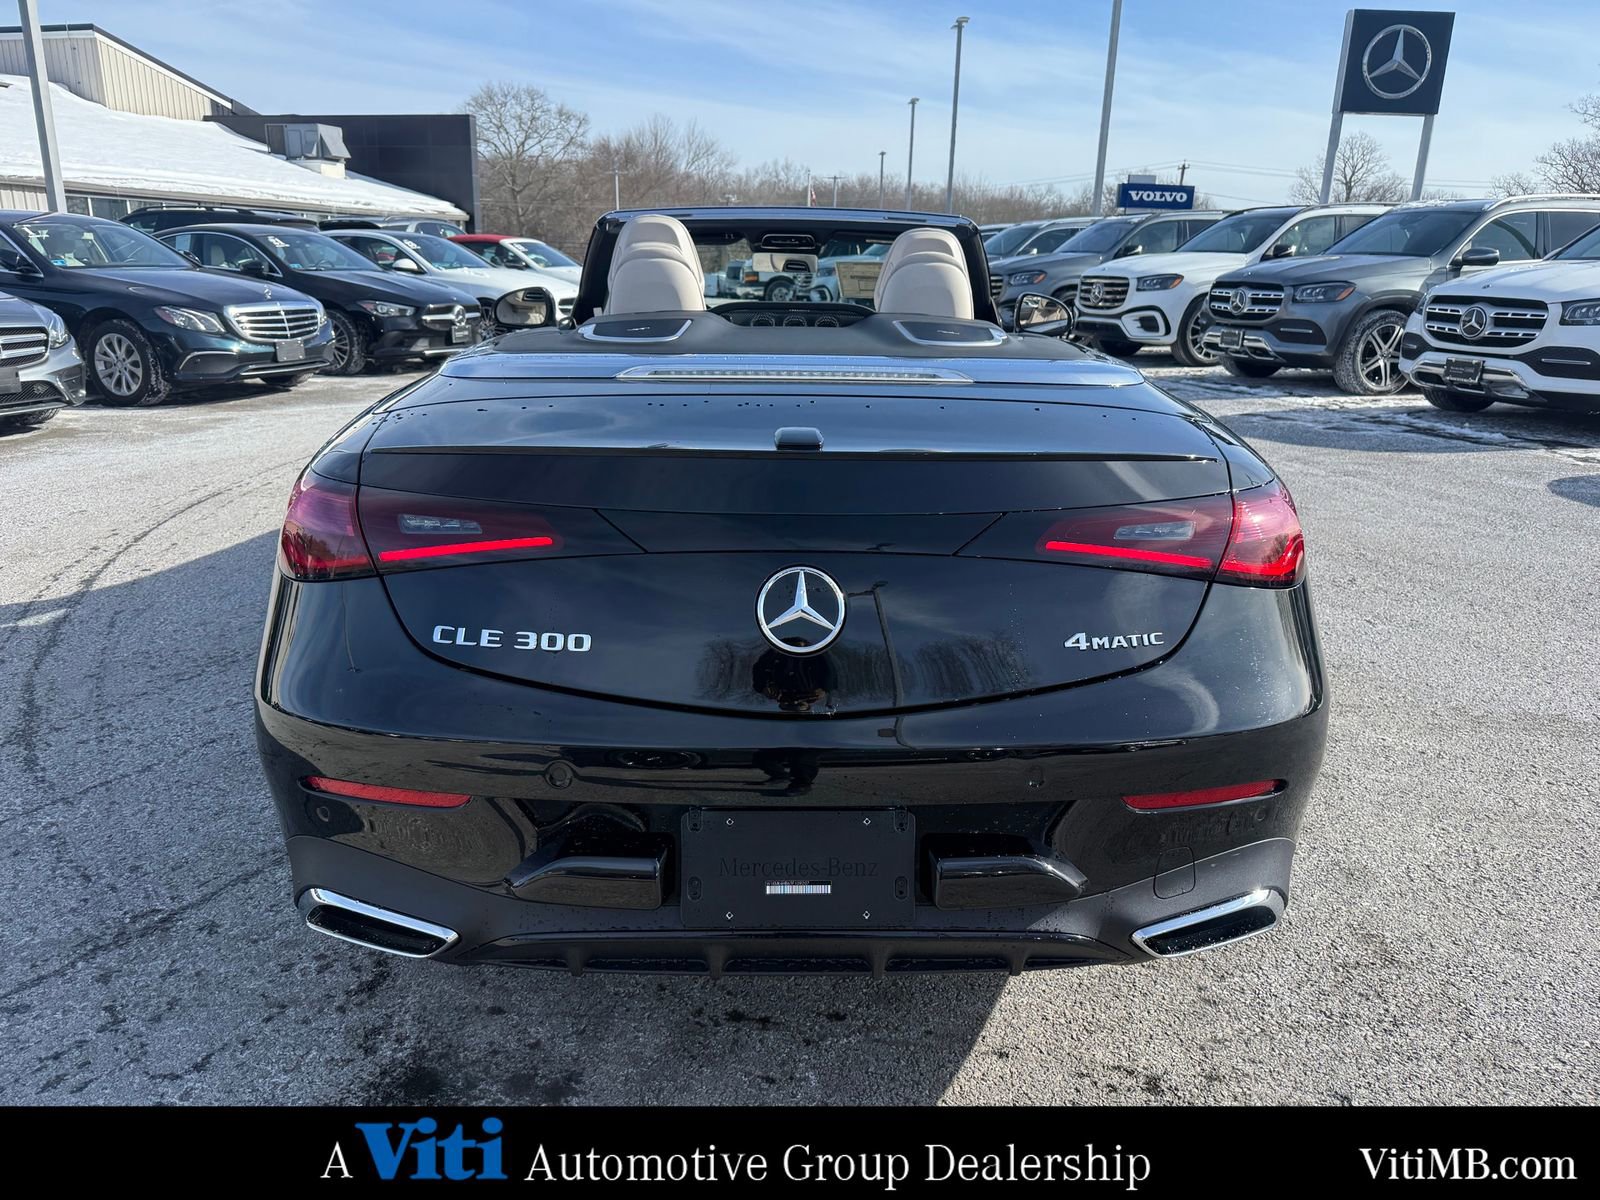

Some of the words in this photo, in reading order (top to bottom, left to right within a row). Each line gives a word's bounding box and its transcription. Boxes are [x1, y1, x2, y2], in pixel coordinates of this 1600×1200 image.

[1128, 190, 1188, 203] VOLVO
[432, 625, 504, 648] CLE
[514, 631, 592, 652] 300
[1064, 632, 1165, 650] 4MATIC
[719, 857, 879, 877] Mercedes-Benz
